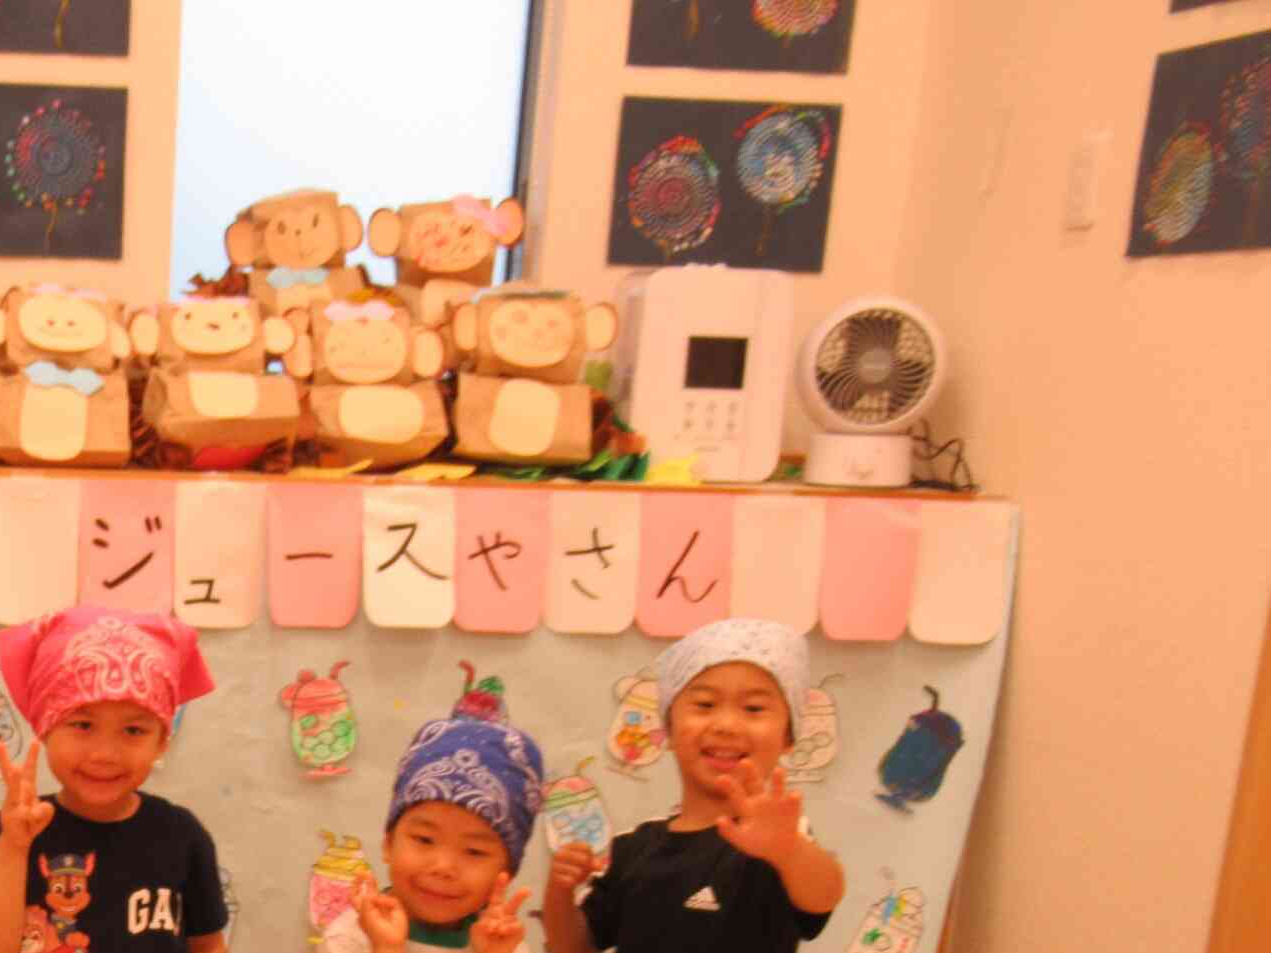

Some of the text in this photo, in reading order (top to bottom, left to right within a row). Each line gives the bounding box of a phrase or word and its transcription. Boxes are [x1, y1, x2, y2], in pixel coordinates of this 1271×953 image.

[92, 517, 718, 604] ジュースやさん
[128, 888, 183, 936] GA
